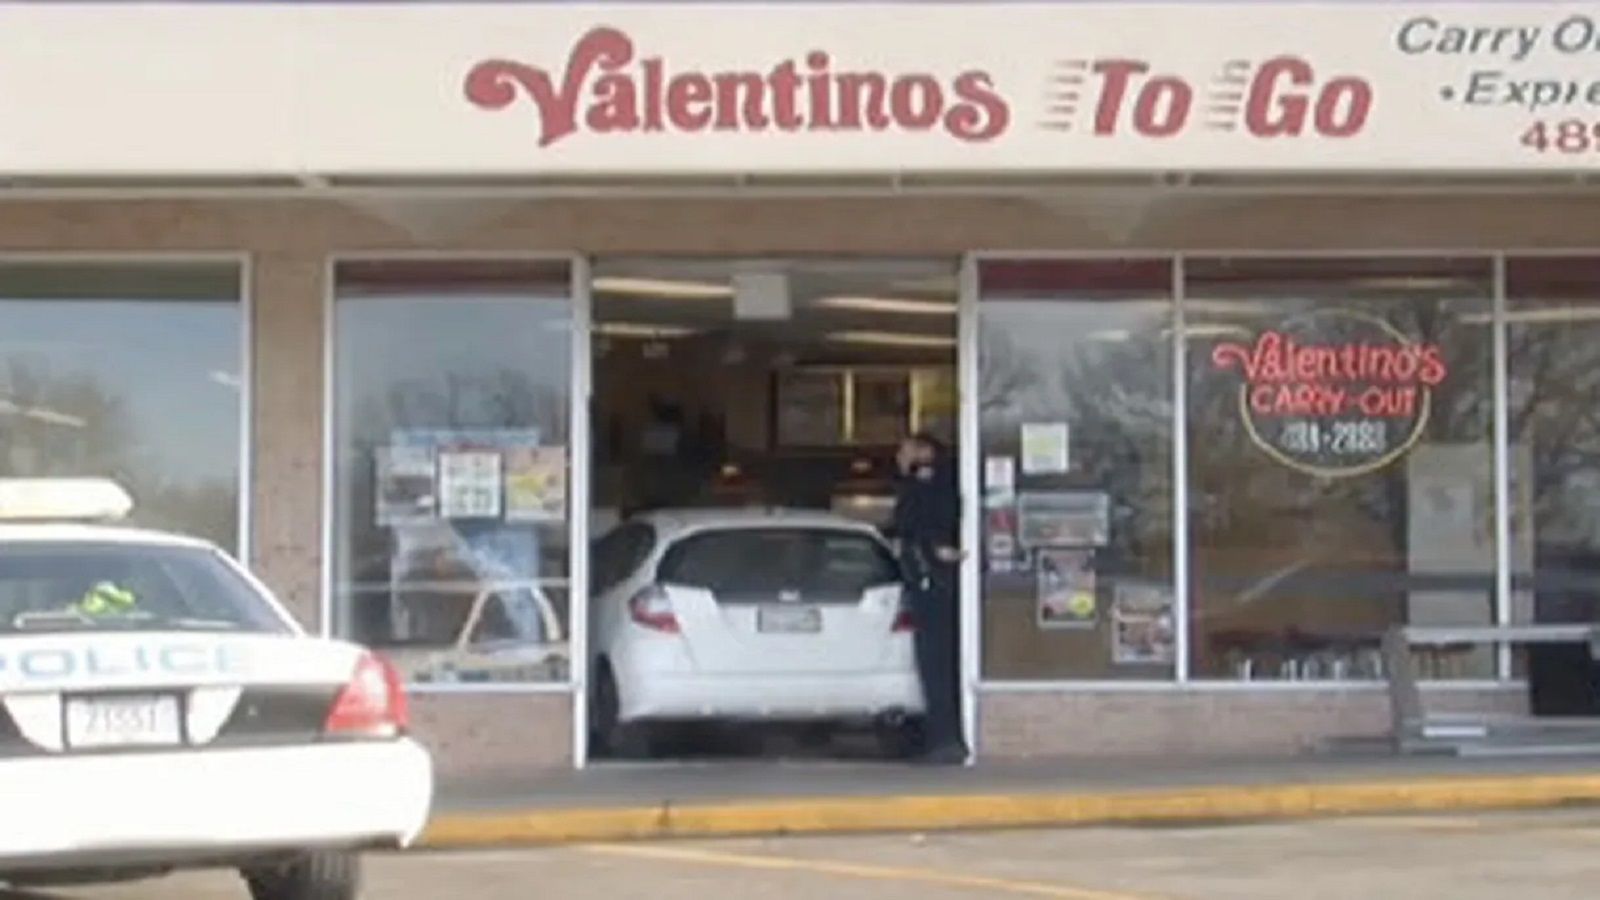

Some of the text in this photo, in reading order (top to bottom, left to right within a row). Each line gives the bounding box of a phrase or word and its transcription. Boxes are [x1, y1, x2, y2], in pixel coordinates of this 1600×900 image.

[1396, 14, 1600, 60] Carry O
[463, 26, 1373, 147] Valentinos To Go
[1519, 118, 1600, 155] 48
[1212, 330, 1447, 385] Valentino's
[0, 644, 248, 679] OLICE
